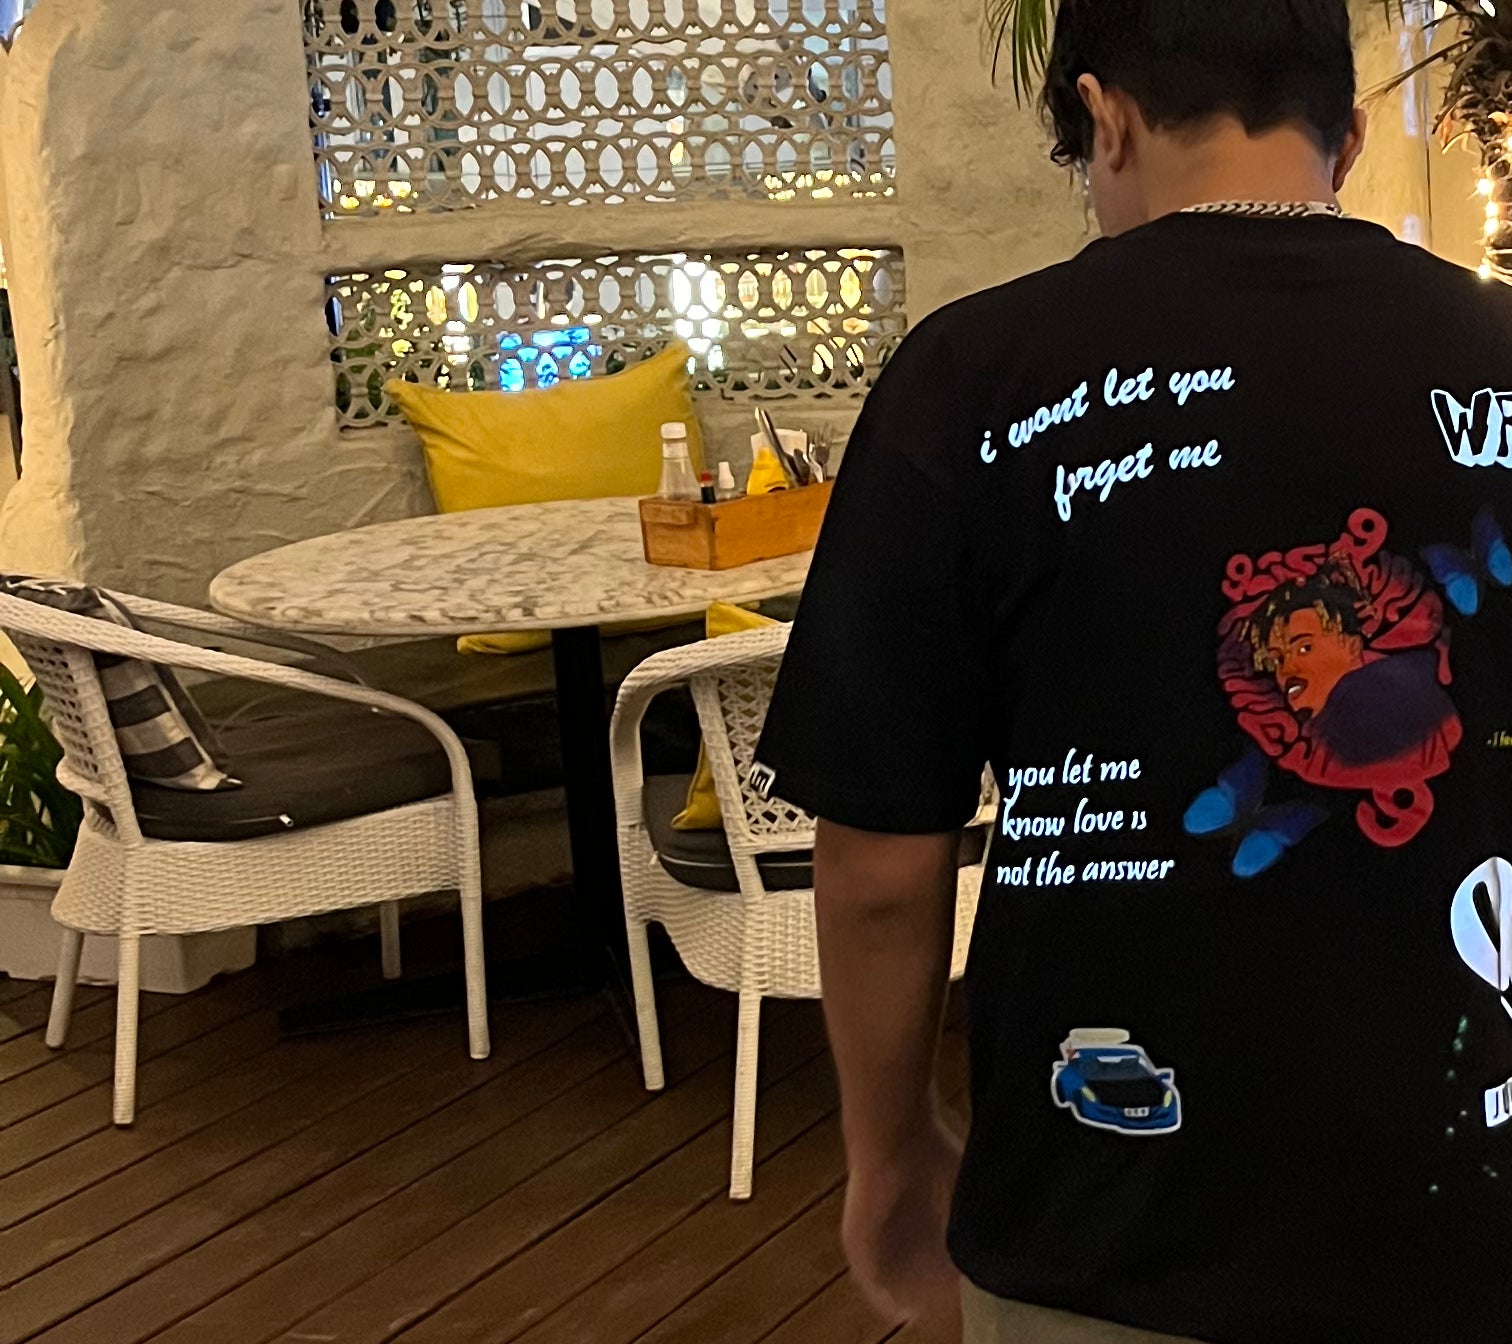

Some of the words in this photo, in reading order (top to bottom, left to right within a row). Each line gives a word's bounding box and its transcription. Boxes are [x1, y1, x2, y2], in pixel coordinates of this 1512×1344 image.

[980, 430, 998, 464] i
[1008, 381, 1090, 448] wont
[1103, 367, 1156, 406] let
[1168, 366, 1236, 406] you
[1168, 439, 1222, 470] me
[1008, 766, 1056, 805] you
[1062, 747, 1094, 784] let
[1100, 758, 1142, 782] me
[1002, 797, 1066, 841] know
[1073, 797, 1124, 834] love
[1130, 810, 1148, 831] is
[996, 857, 1033, 886] not
[1035, 850, 1076, 887] the
[1082, 859, 1176, 882] answer
